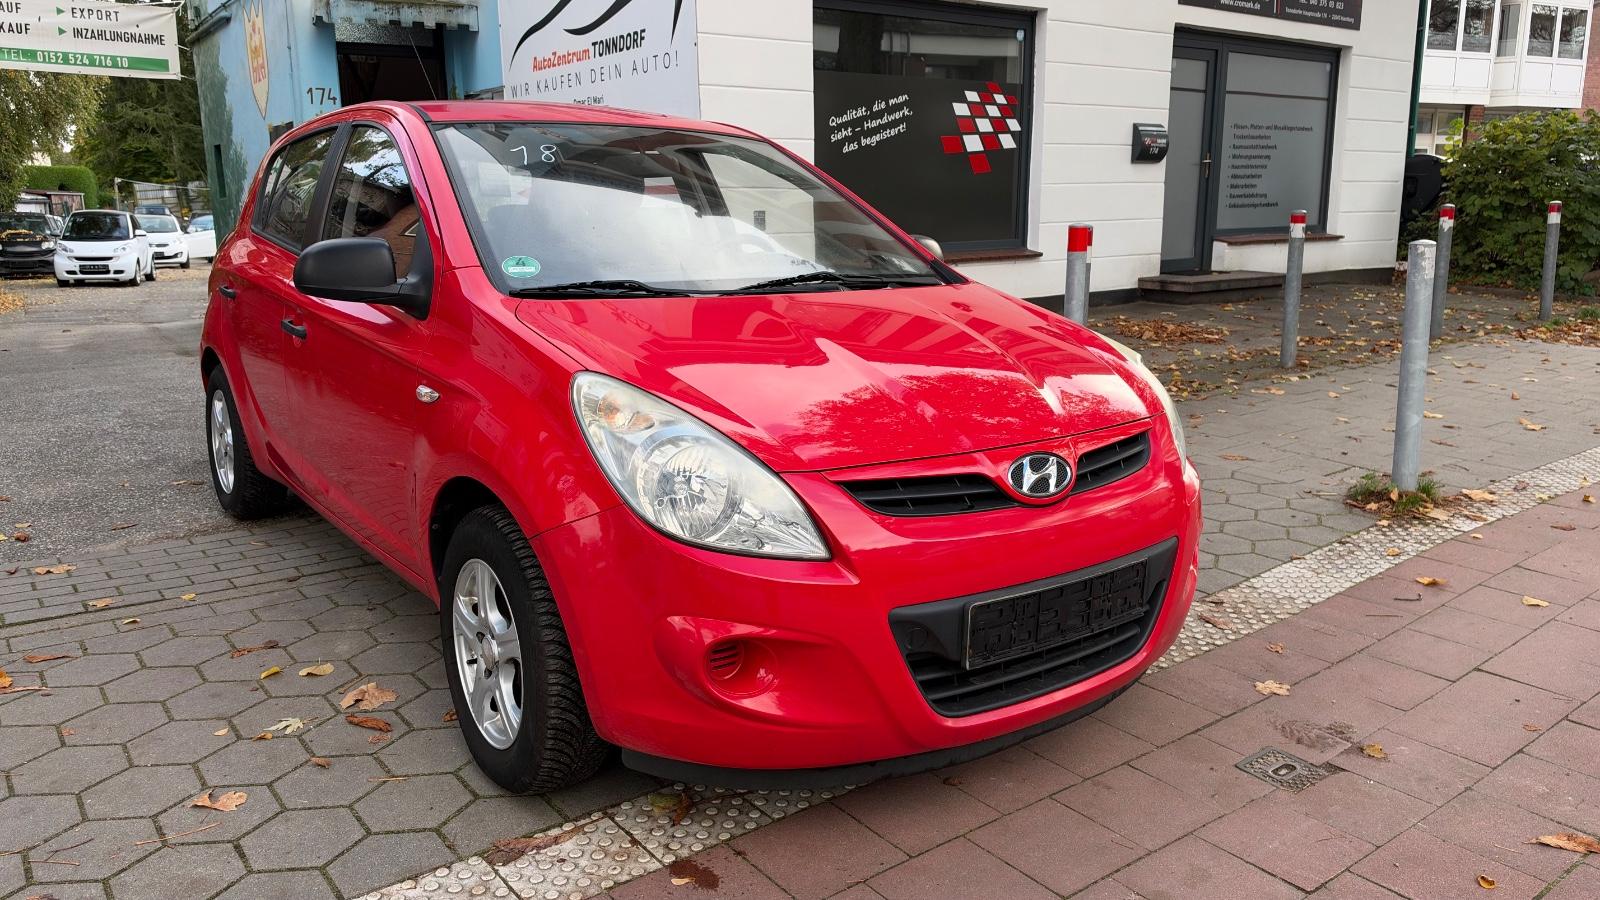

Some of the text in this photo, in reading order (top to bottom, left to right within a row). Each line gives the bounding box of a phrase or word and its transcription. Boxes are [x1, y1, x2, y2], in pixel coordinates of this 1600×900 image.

[71, 7, 120, 22] EXPORT
[73, 27, 165, 46] INZAHLUNGNAHME
[532, 28, 646, 73] AutoZentrum TONNDORF
[37, 51, 64, 64] 0152
[69, 52, 89, 66] 524
[94, 54, 113, 67] 716
[117, 56, 129, 68] 10
[510, 50, 679, 99] WIR KAUFEN DEIN AUTO!
[306, 87, 338, 105] 174
[829, 94, 909, 127] Qualität, die man
[830, 126, 853, 143] sieht
[864, 106, 913, 131] Handwerk,
[842, 122, 907, 153] das begeistert!
